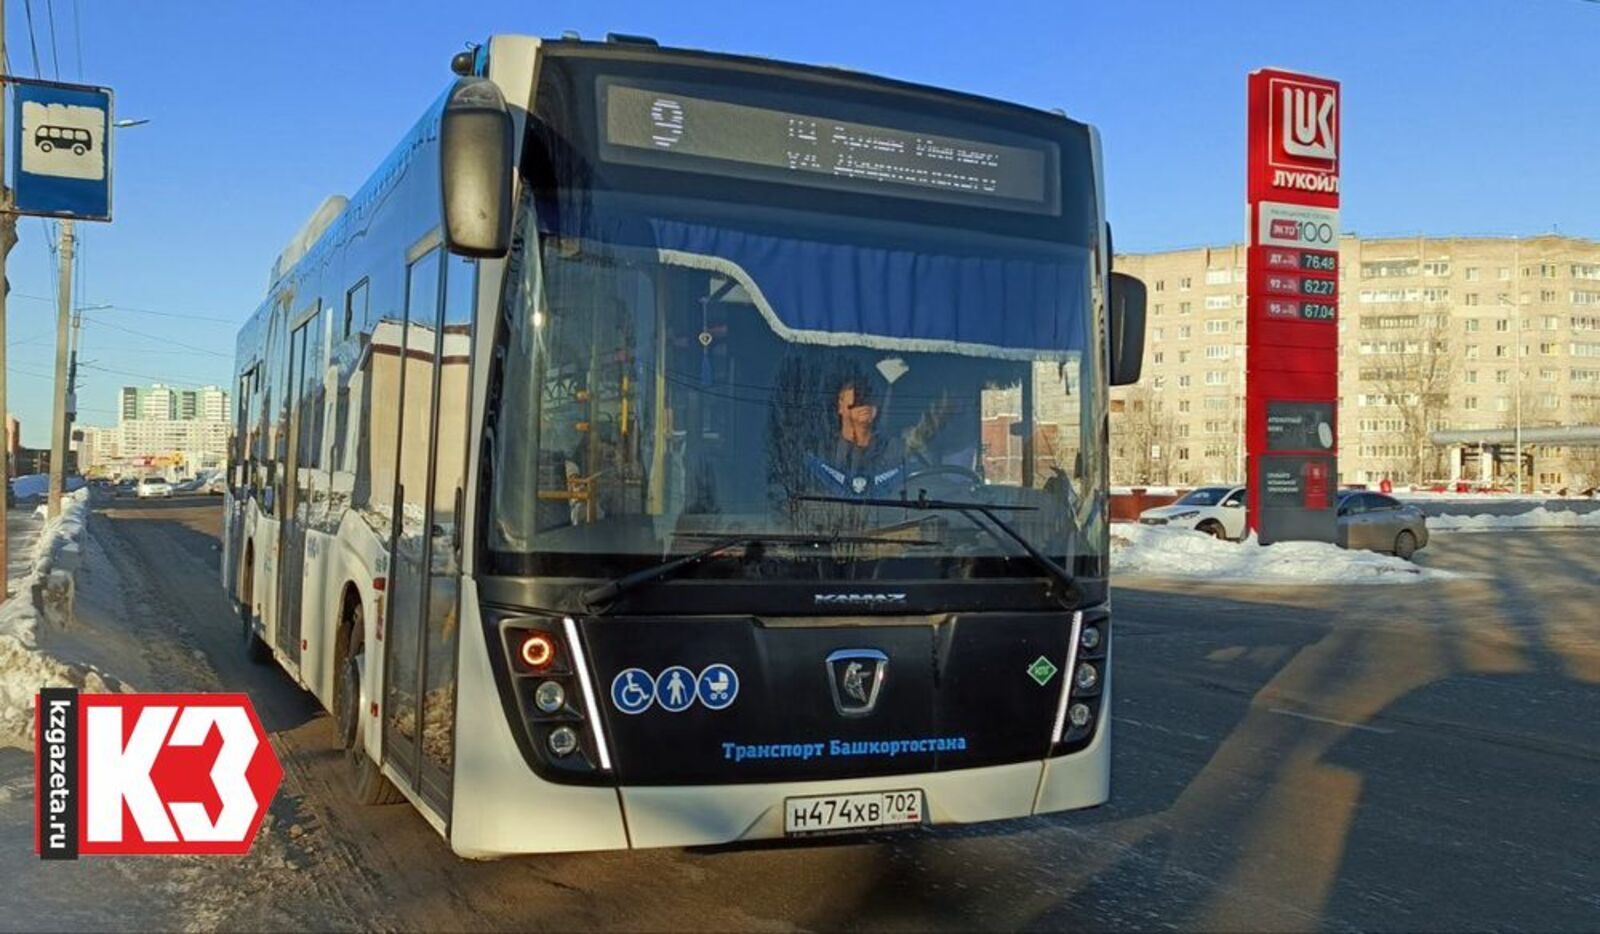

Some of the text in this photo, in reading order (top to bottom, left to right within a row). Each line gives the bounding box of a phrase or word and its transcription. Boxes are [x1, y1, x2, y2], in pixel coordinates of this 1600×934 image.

[651, 99, 684, 148] 9
[1272, 170, 1339, 193] ЛУКОЙЛ
[1297, 221, 1333, 244] 100
[722, 737, 967, 762] Транспорт Башкортостана
[793, 793, 917, 827] Н474ХВ 702
